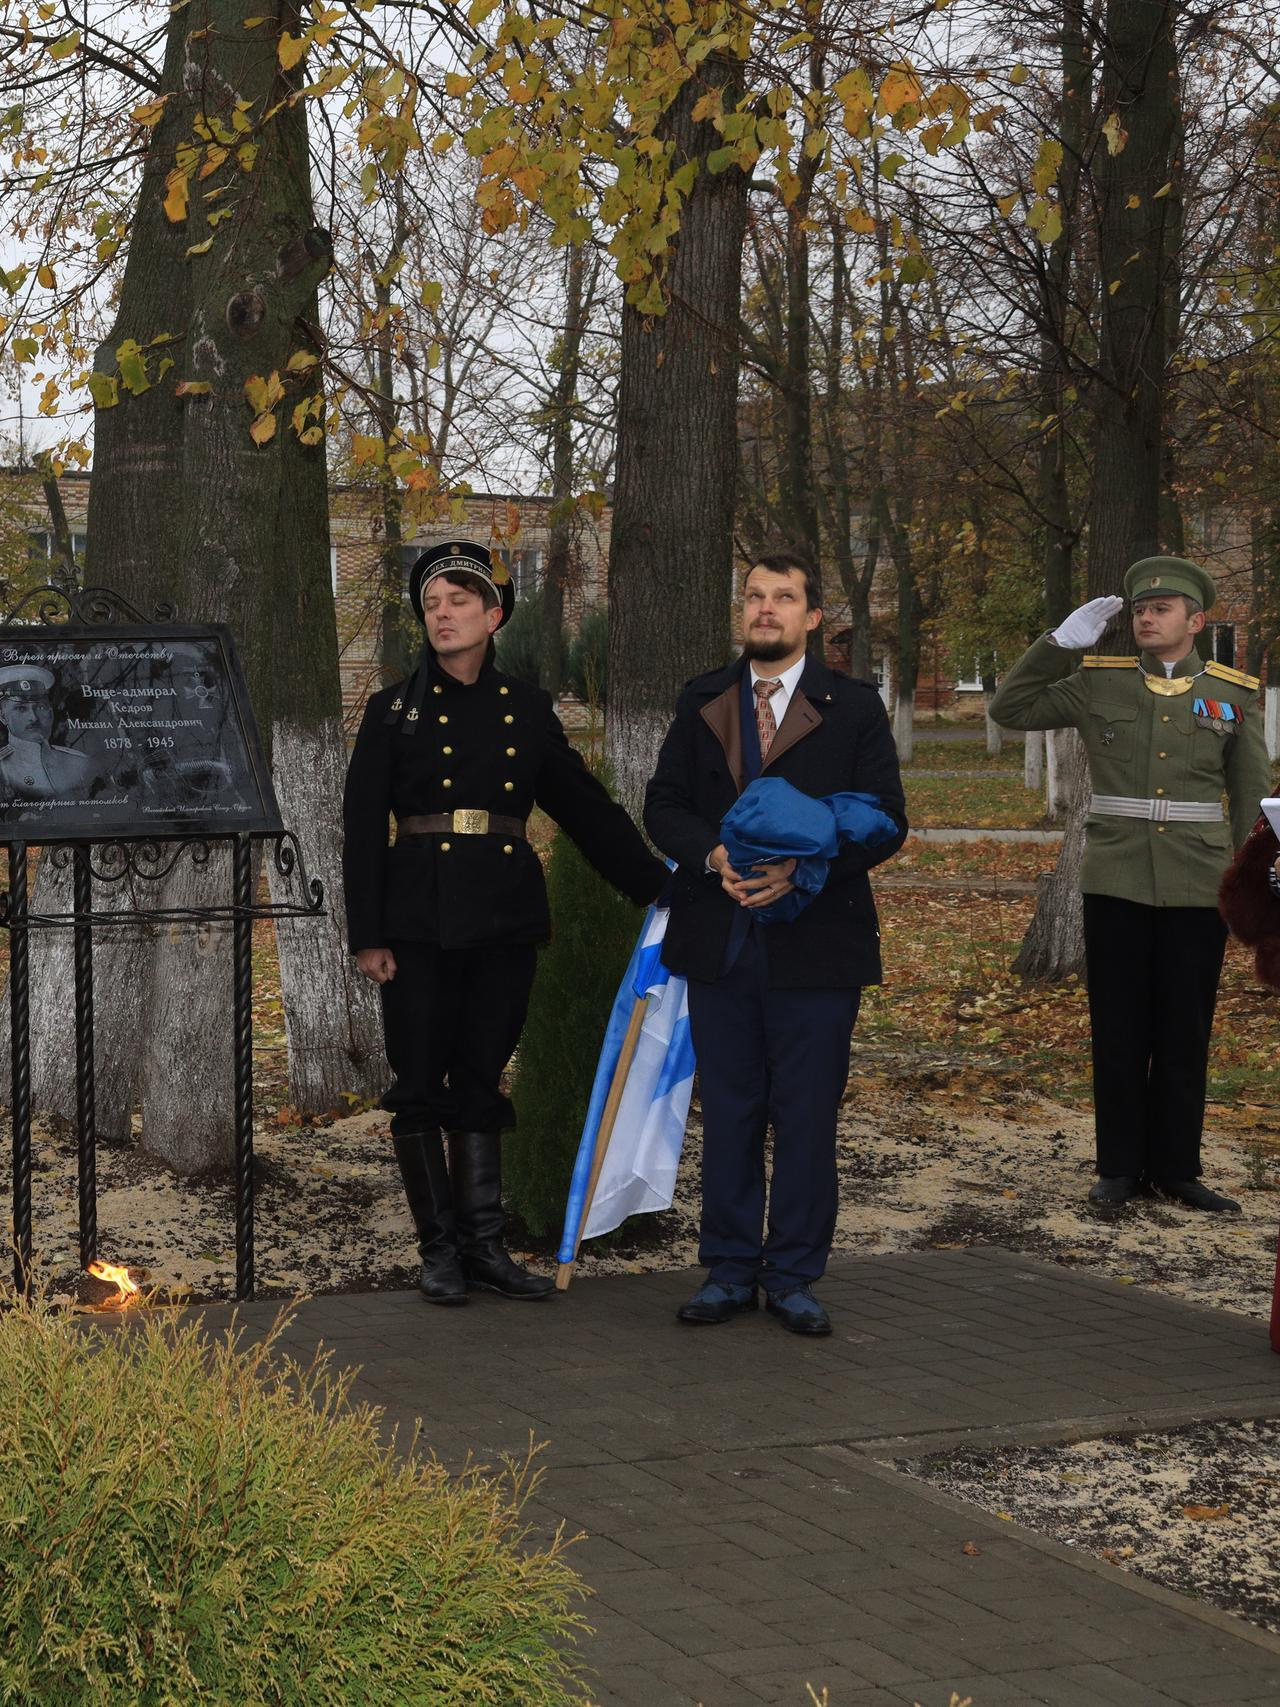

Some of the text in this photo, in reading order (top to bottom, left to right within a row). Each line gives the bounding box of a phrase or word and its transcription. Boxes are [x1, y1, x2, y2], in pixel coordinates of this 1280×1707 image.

[3, 648, 44, 664] Верен
[46, 650, 92, 664] присяге
[105, 647, 174, 663] Отечеству
[81, 684, 177, 699] Вице-адмирал
[111, 701, 153, 714] Кедров
[67, 717, 203, 730] Михаил Александрович
[104, 737, 132, 749] 1878
[146, 737, 174, 748] 1945
[12, 798, 76, 811] благодарных
[79, 795, 129, 806] потомков
